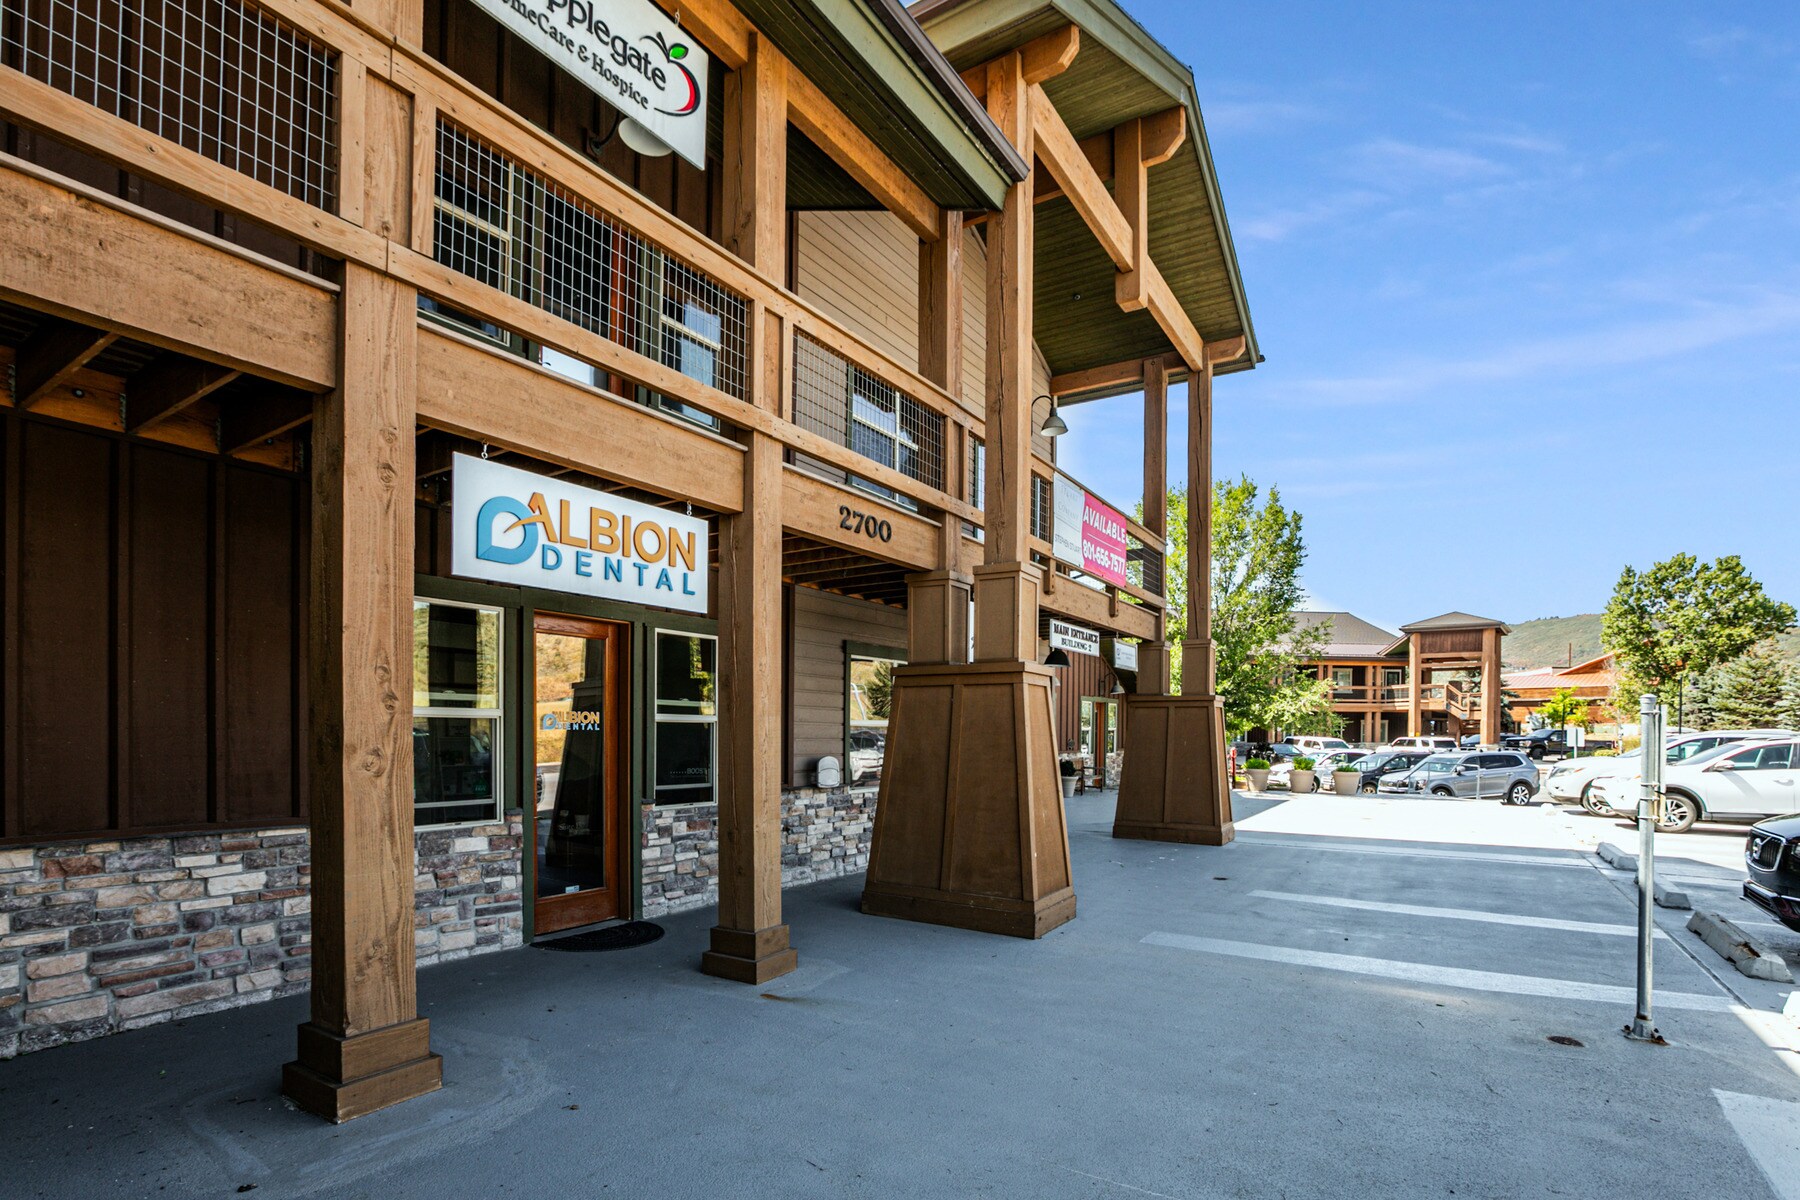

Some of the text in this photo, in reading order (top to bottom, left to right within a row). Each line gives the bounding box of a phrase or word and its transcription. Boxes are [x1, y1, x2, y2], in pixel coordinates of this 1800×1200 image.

[503, 0, 649, 110] meCare & Hospice
[504, 491, 696, 571] ALBION
[839, 504, 892, 543] 2700
[1083, 505, 1126, 544] AVAILABLE
[541, 543, 696, 596] DENTAL
[1053, 623, 1099, 644] MAIN ENTRANCE
[1061, 637, 1087, 650] BUILDING
[552, 710, 600, 724] ALBION
[557, 723, 600, 731] DENTAL
